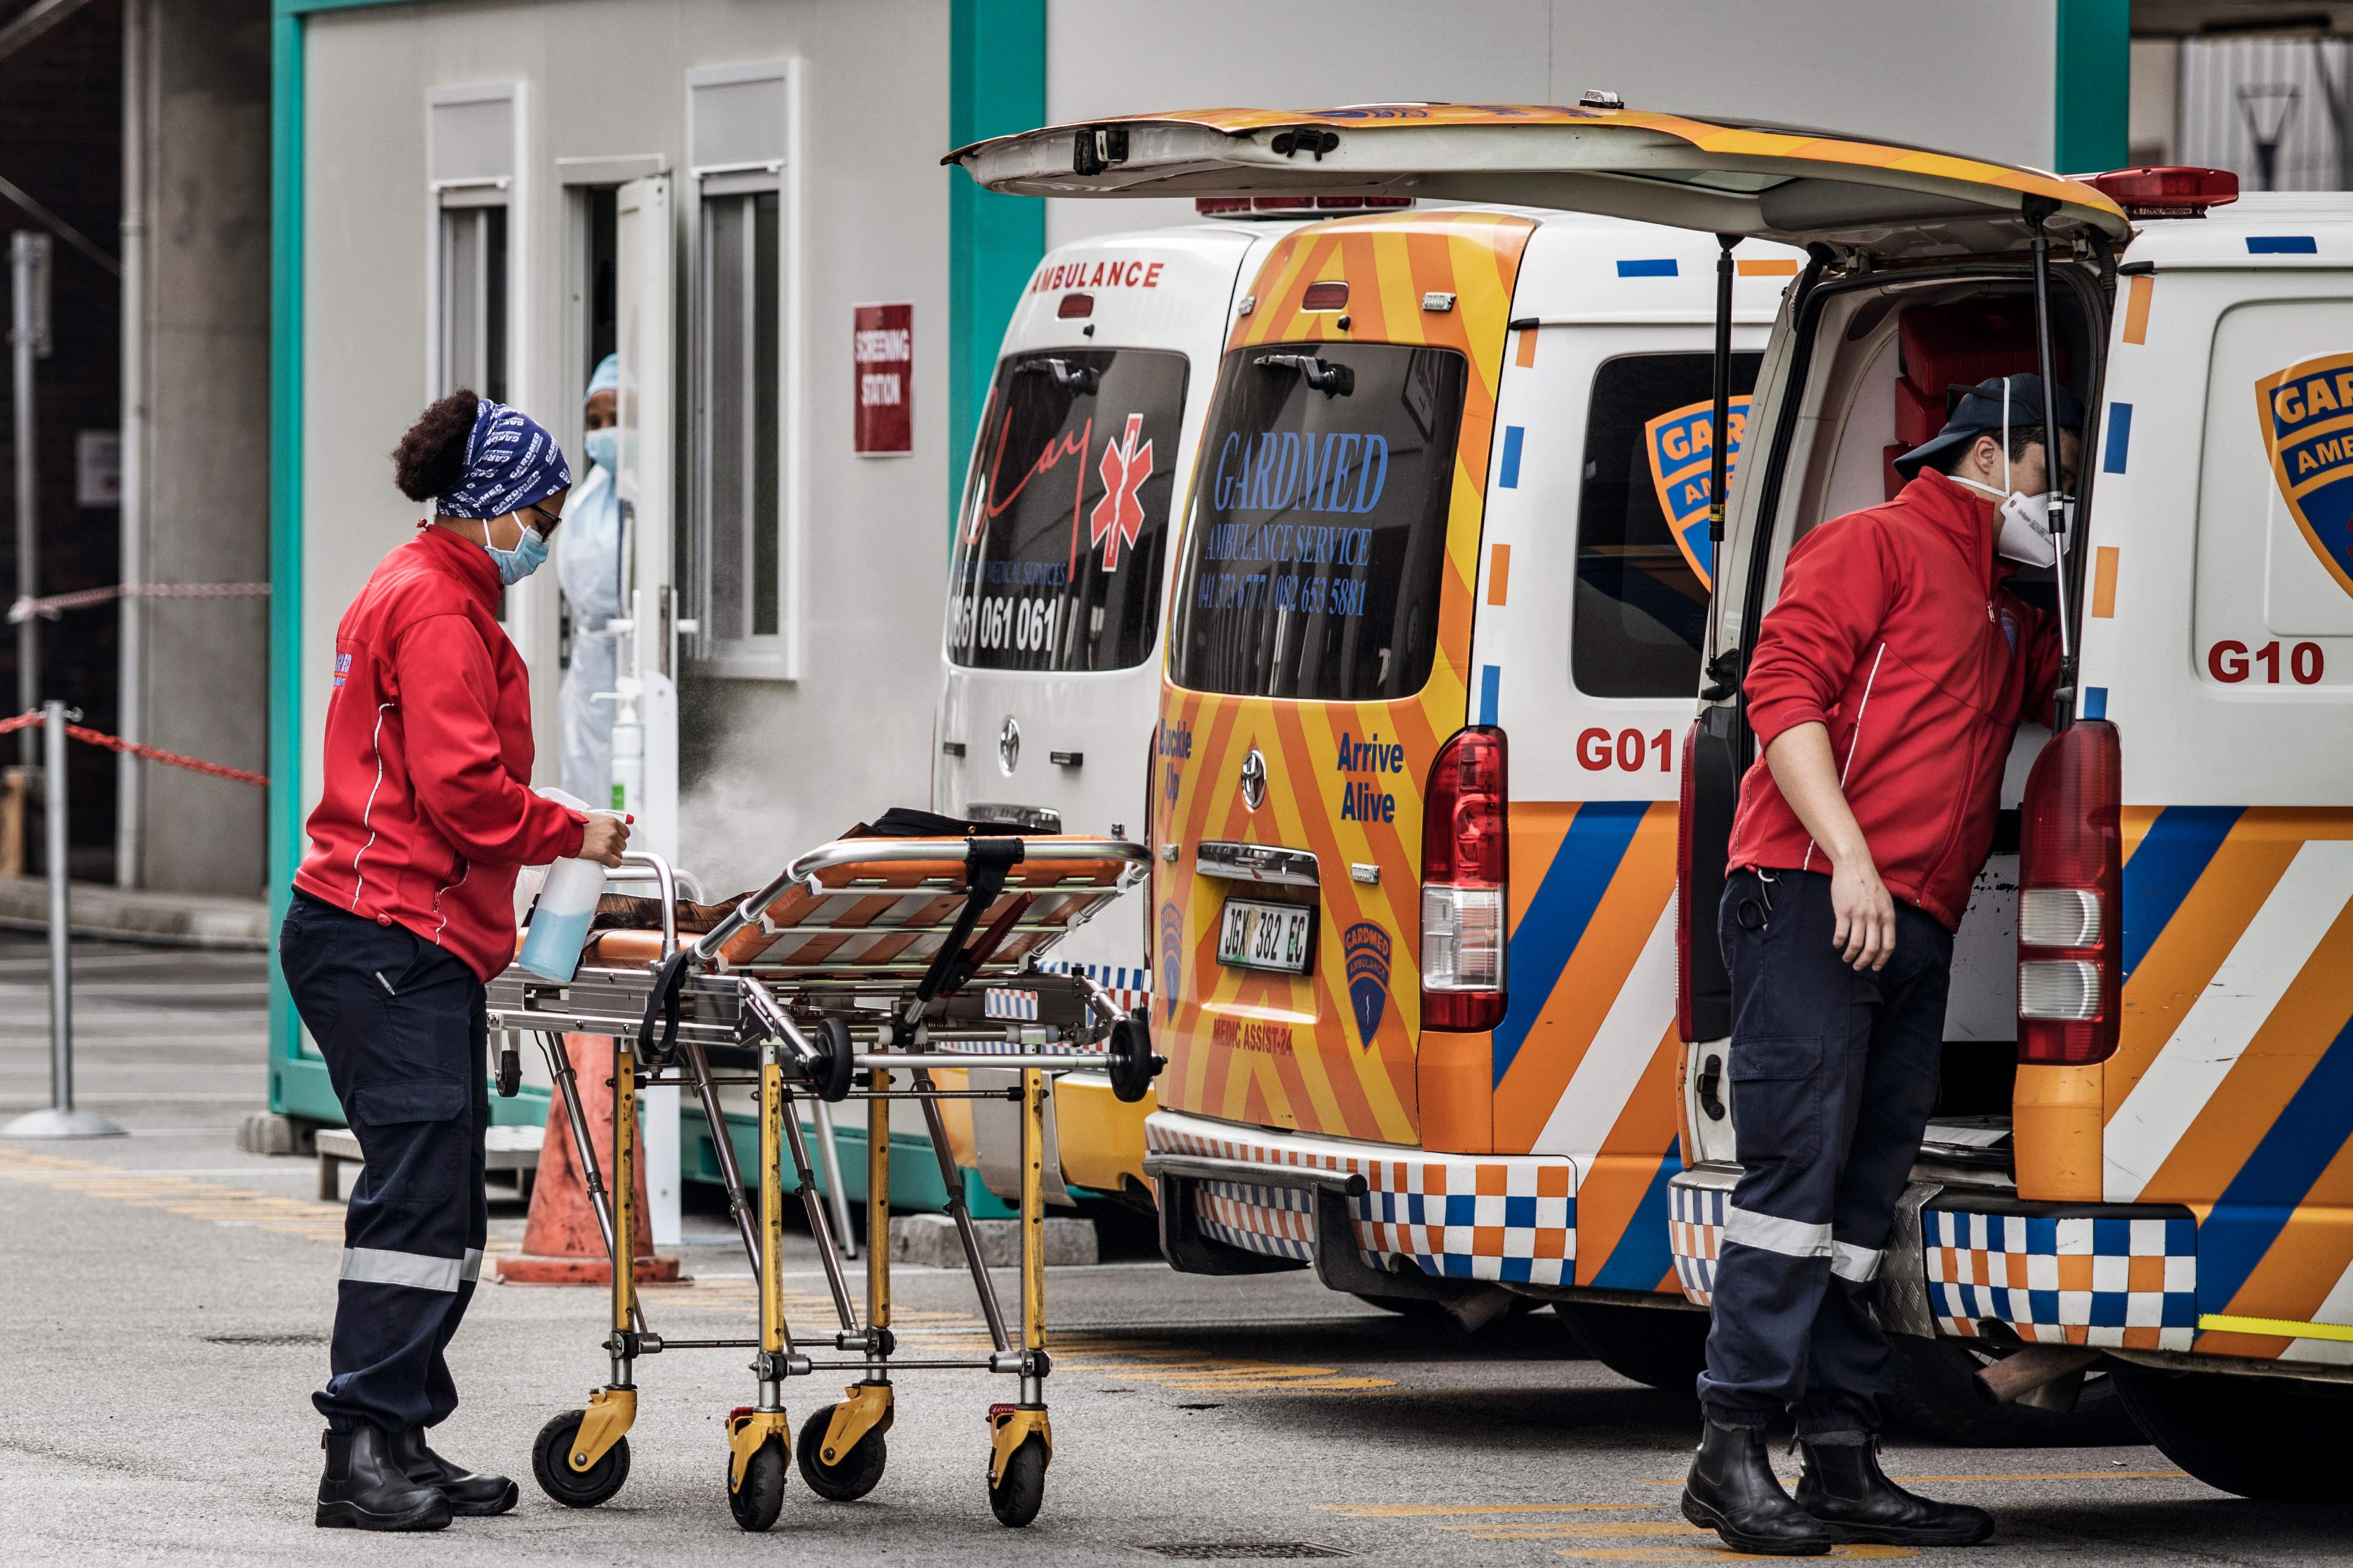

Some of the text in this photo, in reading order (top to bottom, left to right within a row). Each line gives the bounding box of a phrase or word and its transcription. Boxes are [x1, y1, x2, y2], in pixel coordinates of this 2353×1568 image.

[1030, 261, 1164, 293] AMBULANCE
[861, 373, 901, 406] STATION
[510, 432, 540, 478] GARDMED
[1214, 431, 1389, 514] GARDMED
[1205, 523, 1373, 566] AMBULANCE SERVICE
[1198, 572, 1215, 608] 041
[1216, 573, 1236, 609] 373
[1237, 574, 1266, 611] 6777
[1275, 574, 1299, 612] 082
[1301, 577, 1326, 614] 653
[1329, 578, 1366, 617] 5881
[980, 596, 1014, 650] 061
[1016, 597, 1057, 651] 061
[2208, 640, 2325, 685] G10
[1159, 718, 1192, 759] Buckle
[1337, 732, 1404, 773] Arrive
[1576, 727, 1672, 773] G01
[1166, 762, 1180, 810] Up
[1341, 781, 1395, 823] Alive
[1225, 908, 1250, 956] JGX
[1256, 912, 1282, 961] 382
[1286, 915, 1305, 963] EC
[1346, 927, 1389, 956] GARDMED
[1350, 958, 1385, 979] AMBULANCE
[1213, 1018, 1293, 1056] MEDIC ASSIST-24
